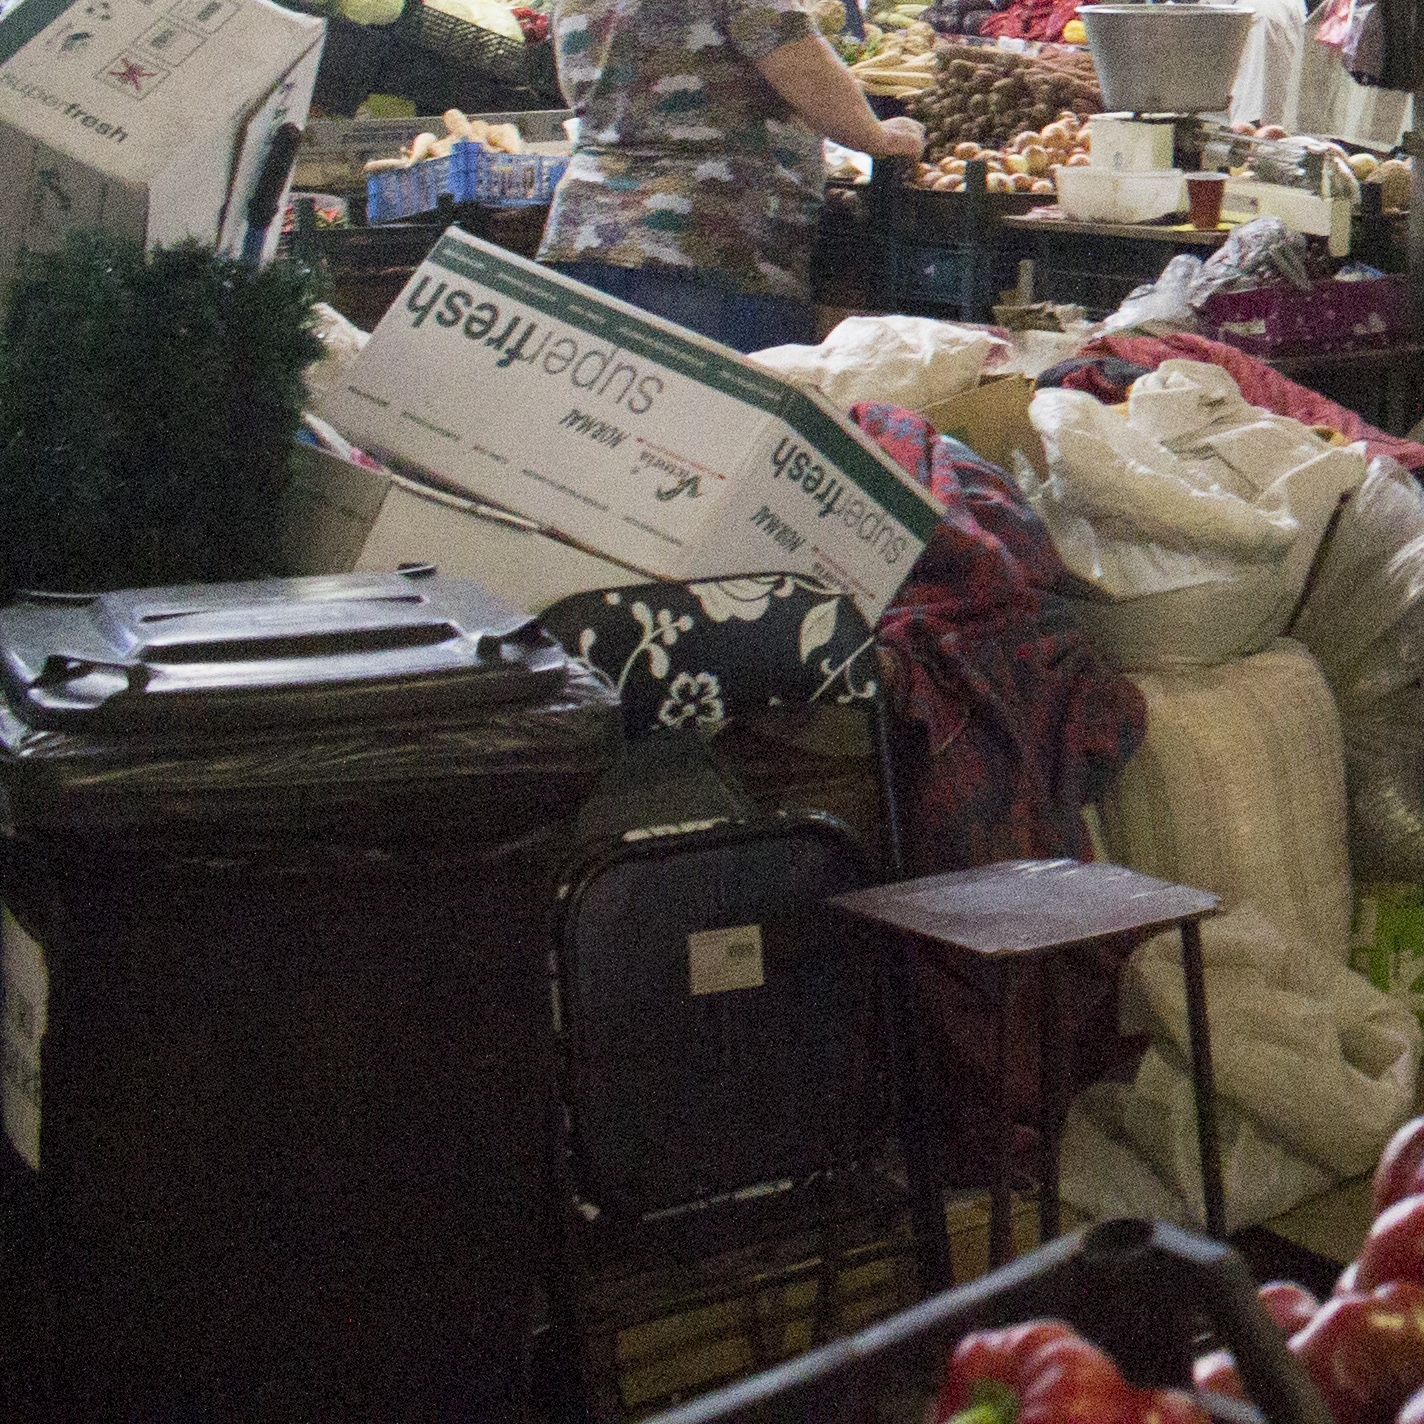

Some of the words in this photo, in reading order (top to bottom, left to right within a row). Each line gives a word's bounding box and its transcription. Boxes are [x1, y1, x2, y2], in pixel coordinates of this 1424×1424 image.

[404, 272, 665, 416] superfresh
[560, 408, 628, 452] NORMAL
[748, 504, 802, 555] NORMAL
[769, 433, 909, 565] superfresh
